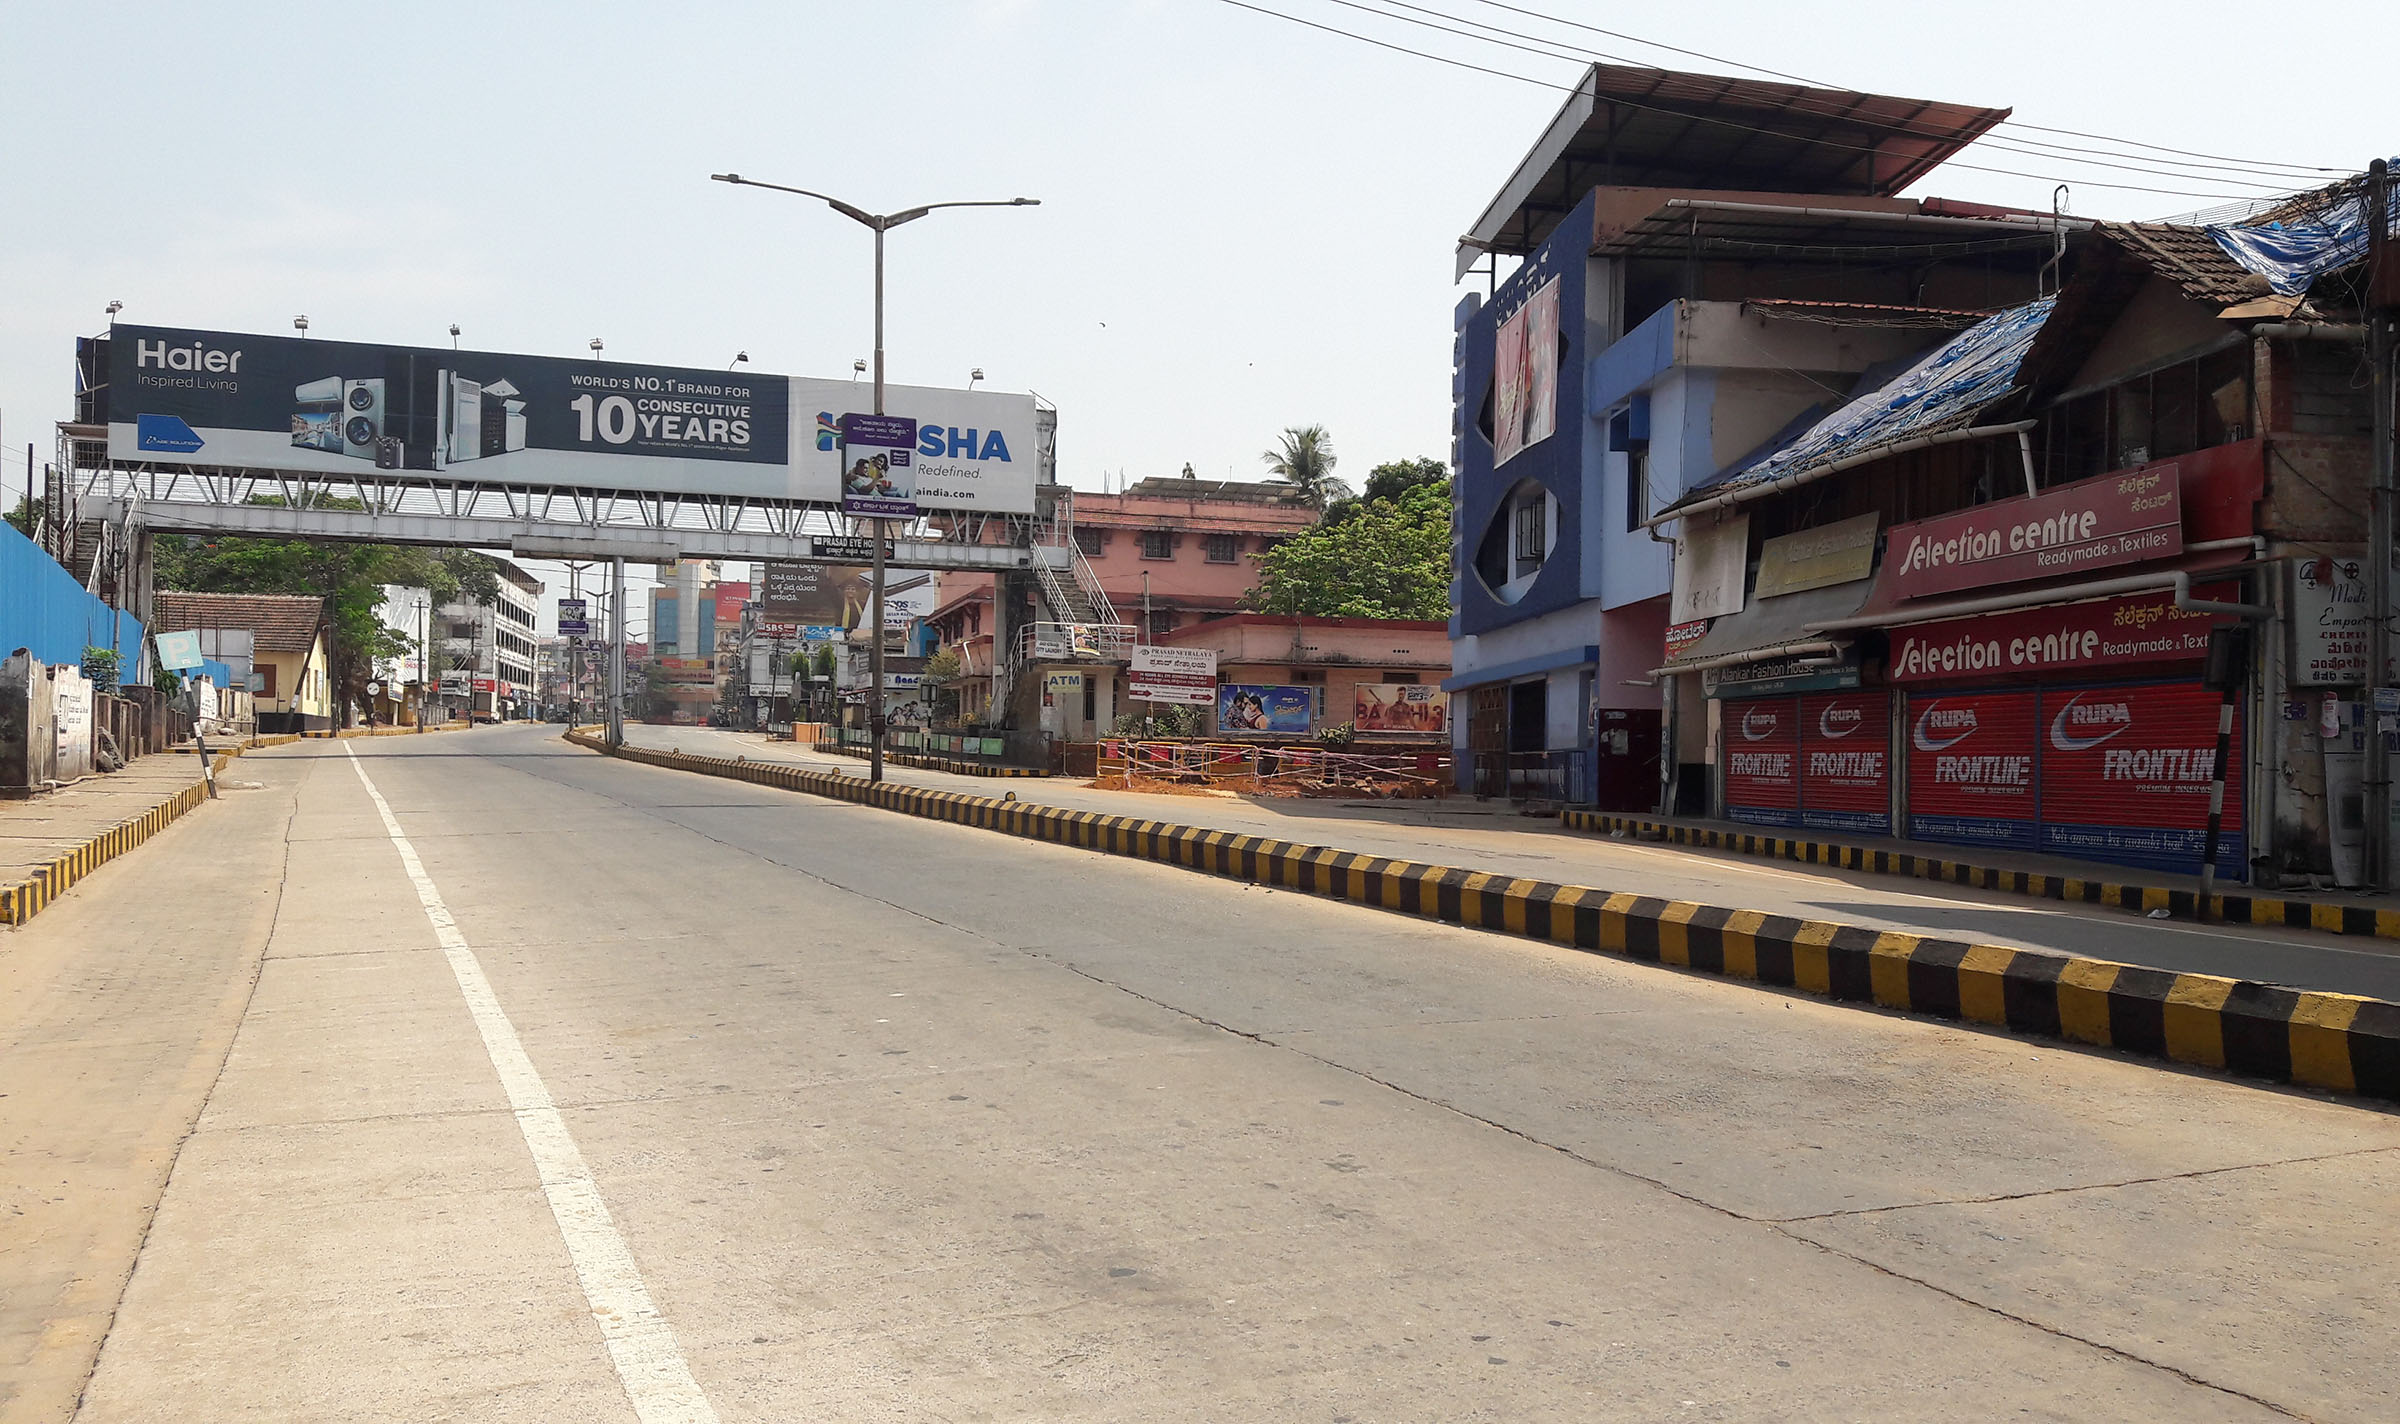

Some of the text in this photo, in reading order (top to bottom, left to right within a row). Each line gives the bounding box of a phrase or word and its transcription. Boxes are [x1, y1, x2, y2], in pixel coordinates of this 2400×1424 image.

[138, 339, 242, 373] Haier
[138, 373, 238, 394] Inspired Living
[571, 374, 630, 389] WORLD'S
[677, 383, 721, 396] BRAND
[725, 386, 750, 398] FOR
[571, 393, 636, 444] 10
[637, 398, 750, 418] CONSECUTIVE
[637, 413, 750, 444] YEARS
[917, 425, 1012, 463] SHA
[918, 464, 982, 479] Redefined.
[916, 487, 975, 499] aindia.com
[823, 537, 893, 549] PRASAD EYE HOAL
[1900, 526, 2001, 576] Selection
[2010, 509, 2097, 549] centre
[2037, 532, 2168, 567] Readymade & Textiles
[2113, 603, 2165, 631] ಸೆಲೆಕ್ಷನ್
[168, 637, 189, 664] P
[1894, 624, 2210, 679] Selection centre Readymade & Text
[1049, 675, 1080, 686] ATM
[1752, 662, 1785, 678] Fashion
[1786, 659, 1815, 675] House
[1356, 702, 1429, 722] BAHI
[1750, 714, 1777, 725] RUPA
[1830, 709, 1861, 721] RUPA
[1930, 709, 1978, 728] RUPA
[2072, 703, 2132, 724] RUPA
[1731, 753, 1791, 777] FRONTLINE
[1810, 752, 1883, 778] FRONTLINE
[1935, 756, 2032, 785] FRONTLINE
[2104, 748, 2217, 781] FRONTLIN
